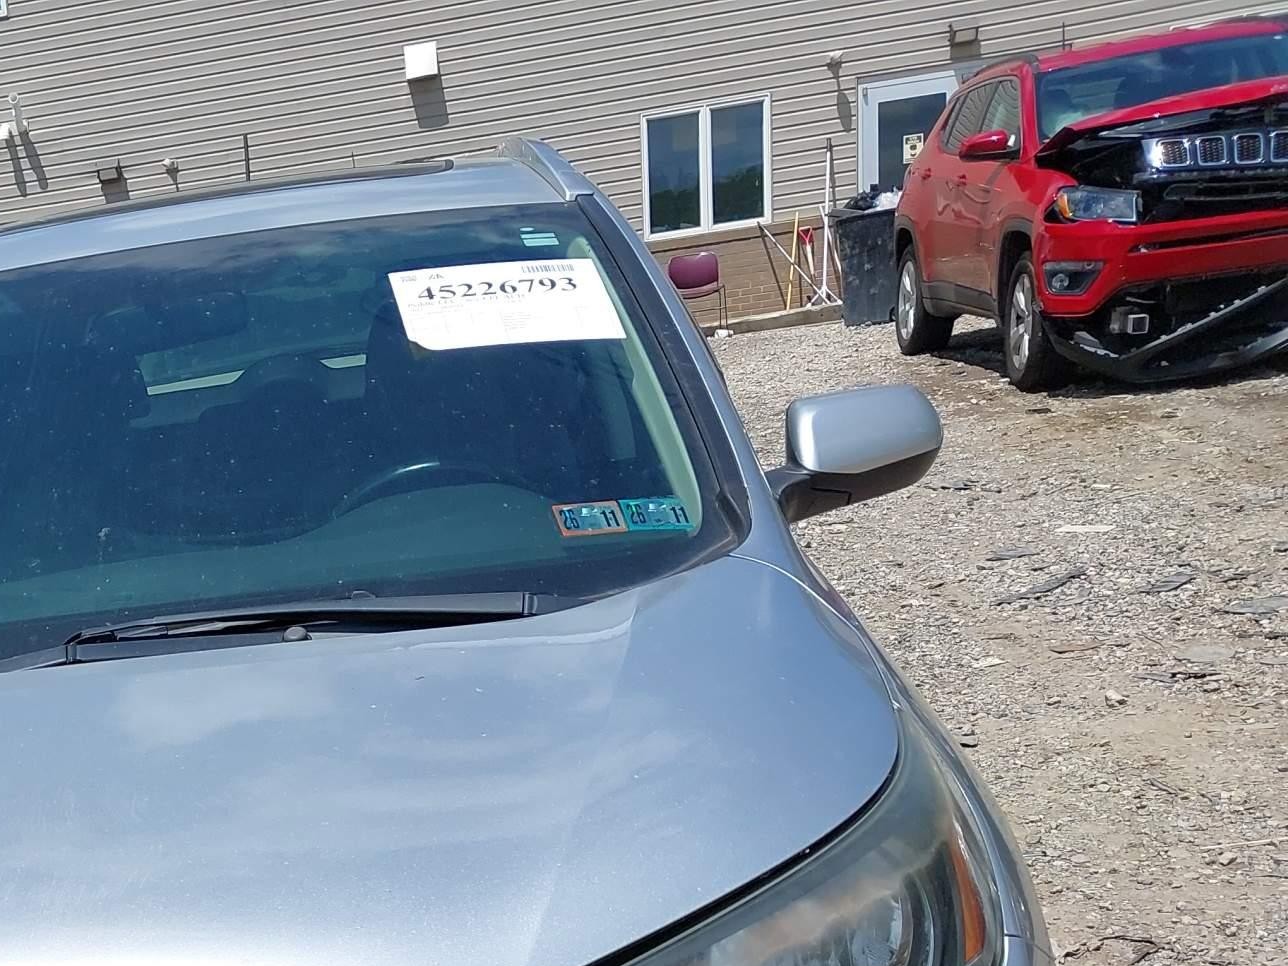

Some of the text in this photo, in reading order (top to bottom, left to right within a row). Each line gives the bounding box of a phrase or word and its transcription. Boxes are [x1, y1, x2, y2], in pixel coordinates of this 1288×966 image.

[418, 276, 578, 301] 45226793
[600, 508, 621, 528] 11
[670, 505, 690, 524] 11
